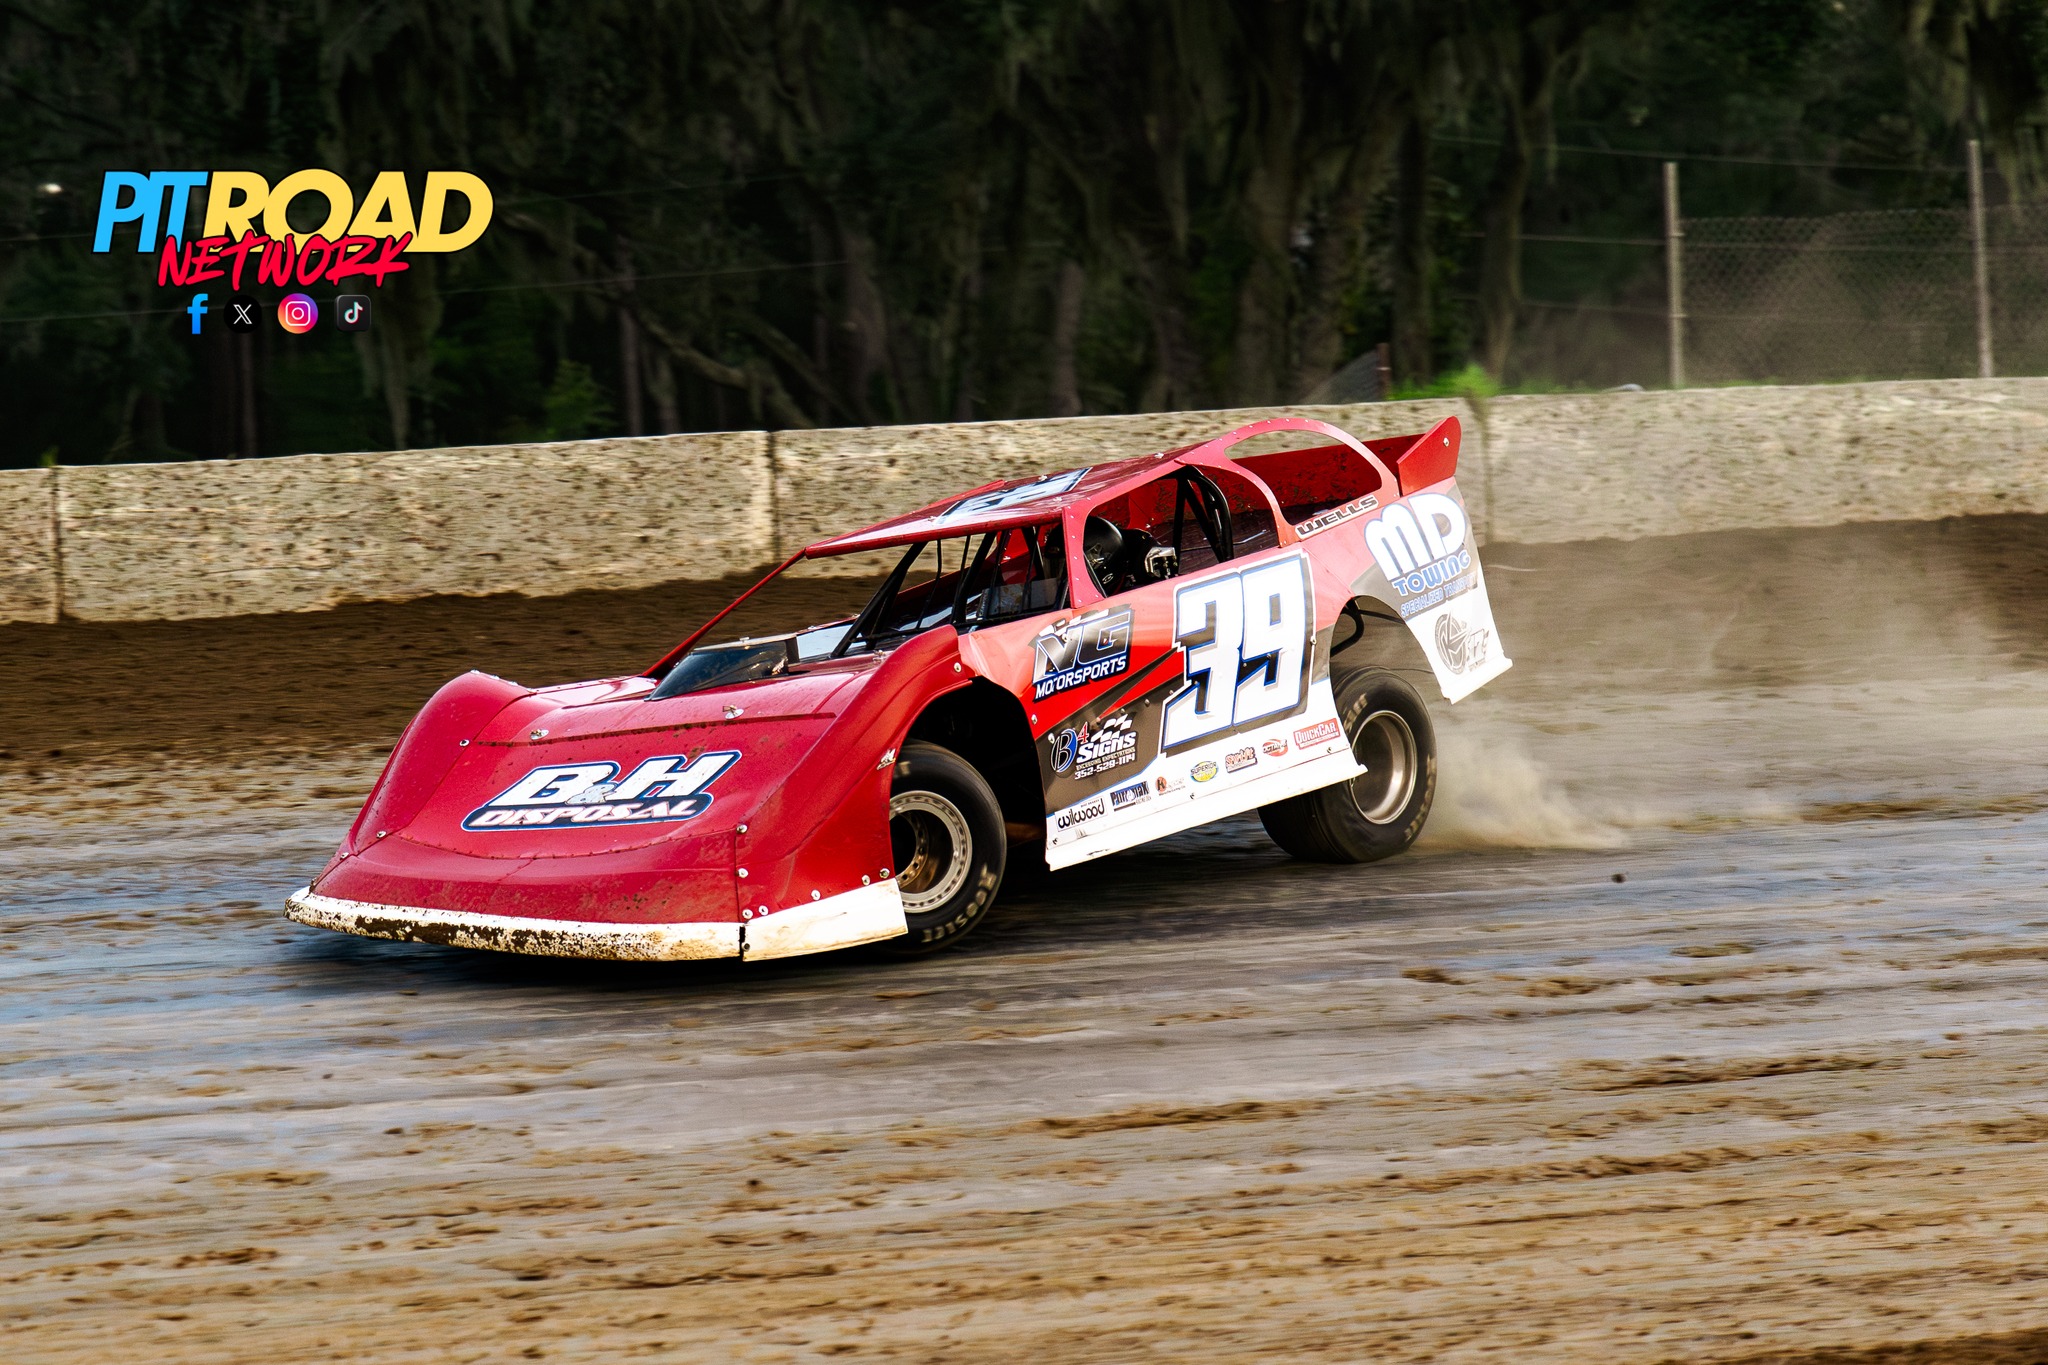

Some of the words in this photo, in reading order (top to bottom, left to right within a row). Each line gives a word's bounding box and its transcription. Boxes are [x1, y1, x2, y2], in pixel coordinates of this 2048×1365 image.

[1297, 496, 1378, 536] WELLS
[1364, 493, 1466, 581] MD
[1392, 549, 1471, 596] TOWING
[1033, 610, 1131, 684] NG
[1163, 555, 1311, 756] 39
[1035, 655, 1127, 700] MOTORSPORTS
[1076, 732, 1137, 763] SIGNS
[1190, 761, 1217, 775] SUPERIOR
[487, 751, 741, 807] B&H
[467, 800, 698, 826] DISPOSAL
[1057, 798, 1105, 829] wilwood
